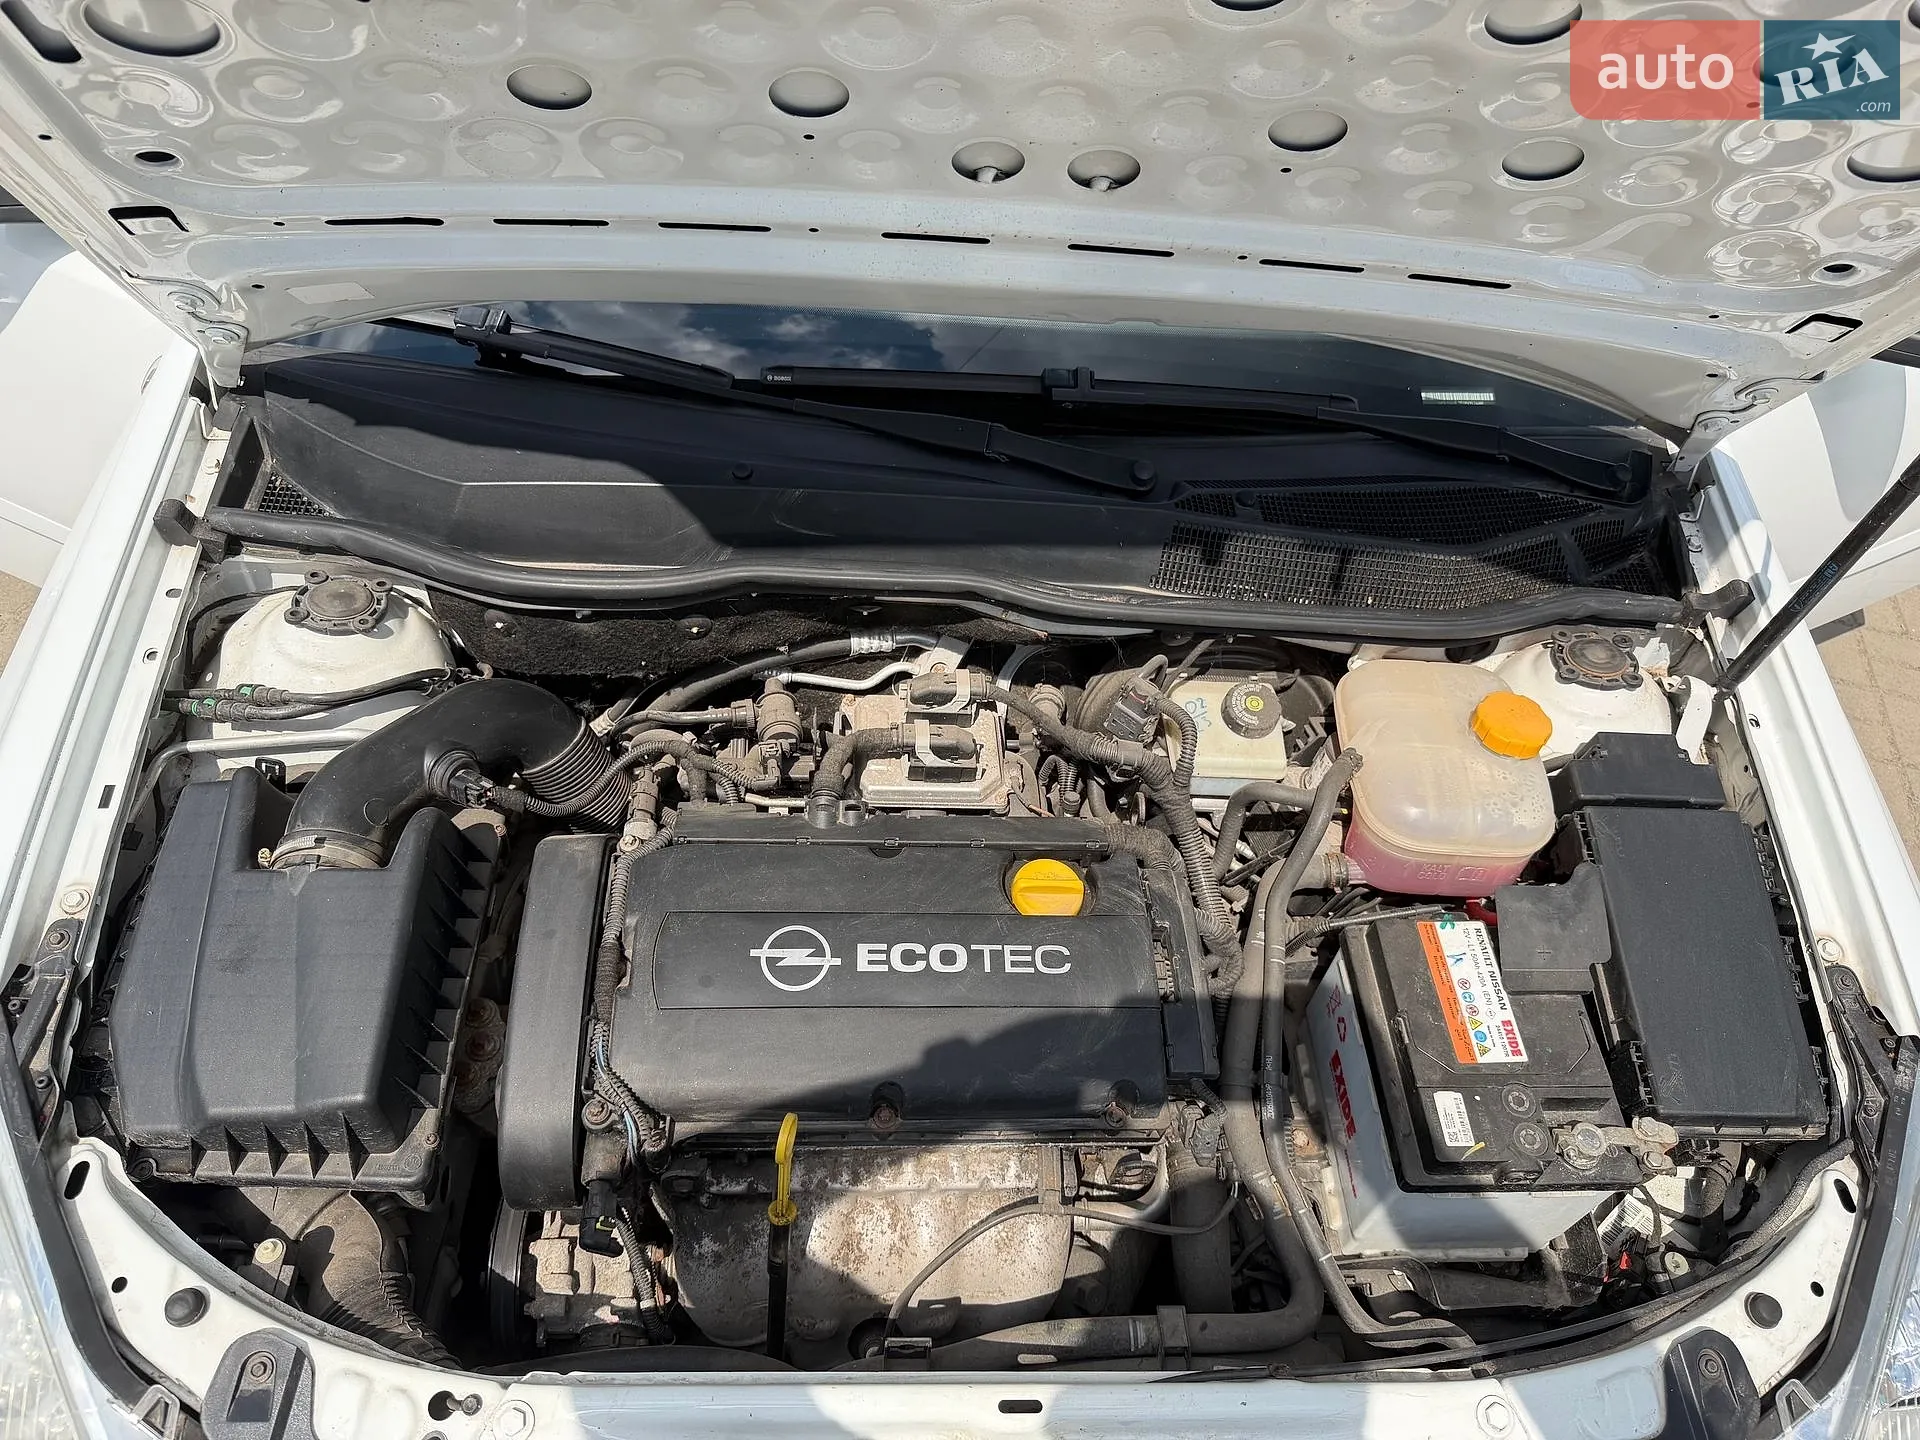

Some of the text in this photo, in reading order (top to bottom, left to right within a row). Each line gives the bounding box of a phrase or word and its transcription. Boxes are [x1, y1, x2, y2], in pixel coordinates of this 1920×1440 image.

[857, 943, 1072, 974] ECOTEC
[1474, 927, 1493, 967] RENAULT
[1488, 970, 1507, 1010] NISSAN
[1501, 1020, 1523, 1057] EXIDE
[1330, 1049, 1357, 1140] EXIDE
